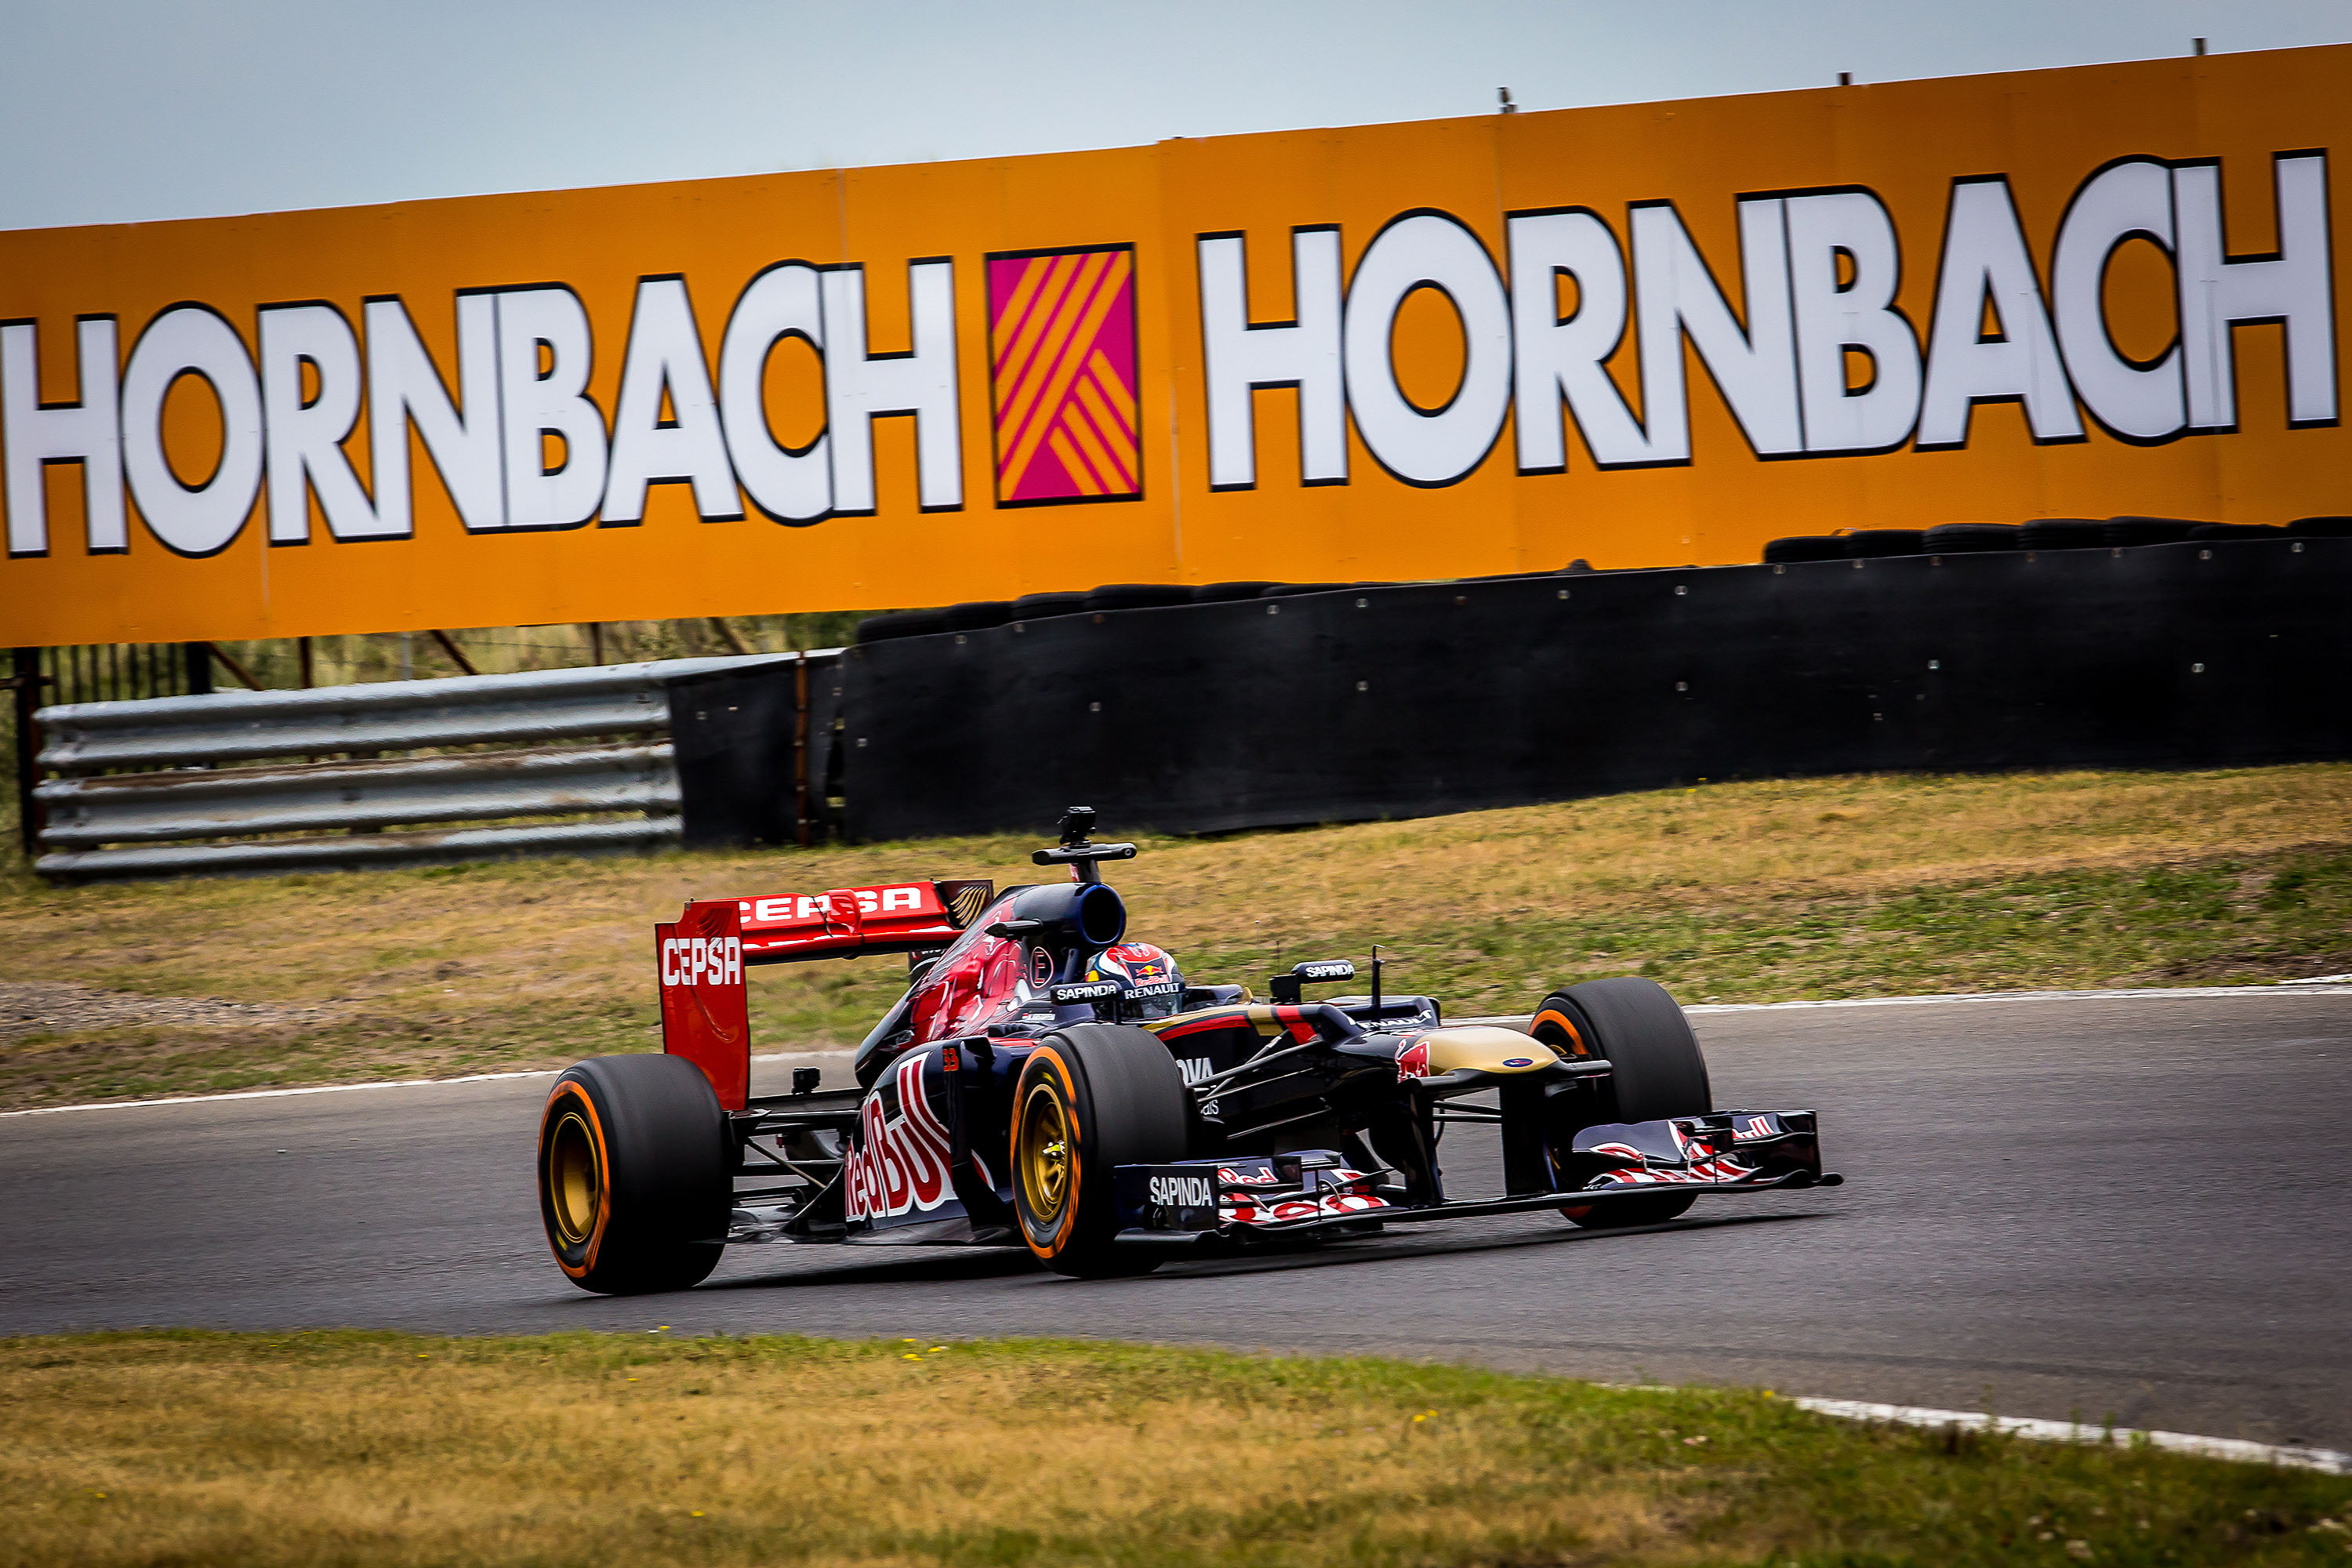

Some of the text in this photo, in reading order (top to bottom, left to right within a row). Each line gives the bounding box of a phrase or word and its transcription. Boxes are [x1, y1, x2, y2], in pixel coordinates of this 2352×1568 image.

[1195, 147, 2340, 493] HORNBACH
[0, 256, 964, 559] HORNBACH
[662, 936, 741, 986] CEPSA
[1305, 964, 1356, 978] SAPINDA
[1057, 984, 1117, 1000] SAPINDA
[1123, 982, 1180, 1000] RENAULT
[1149, 1176, 1213, 1207] SAPINDA
